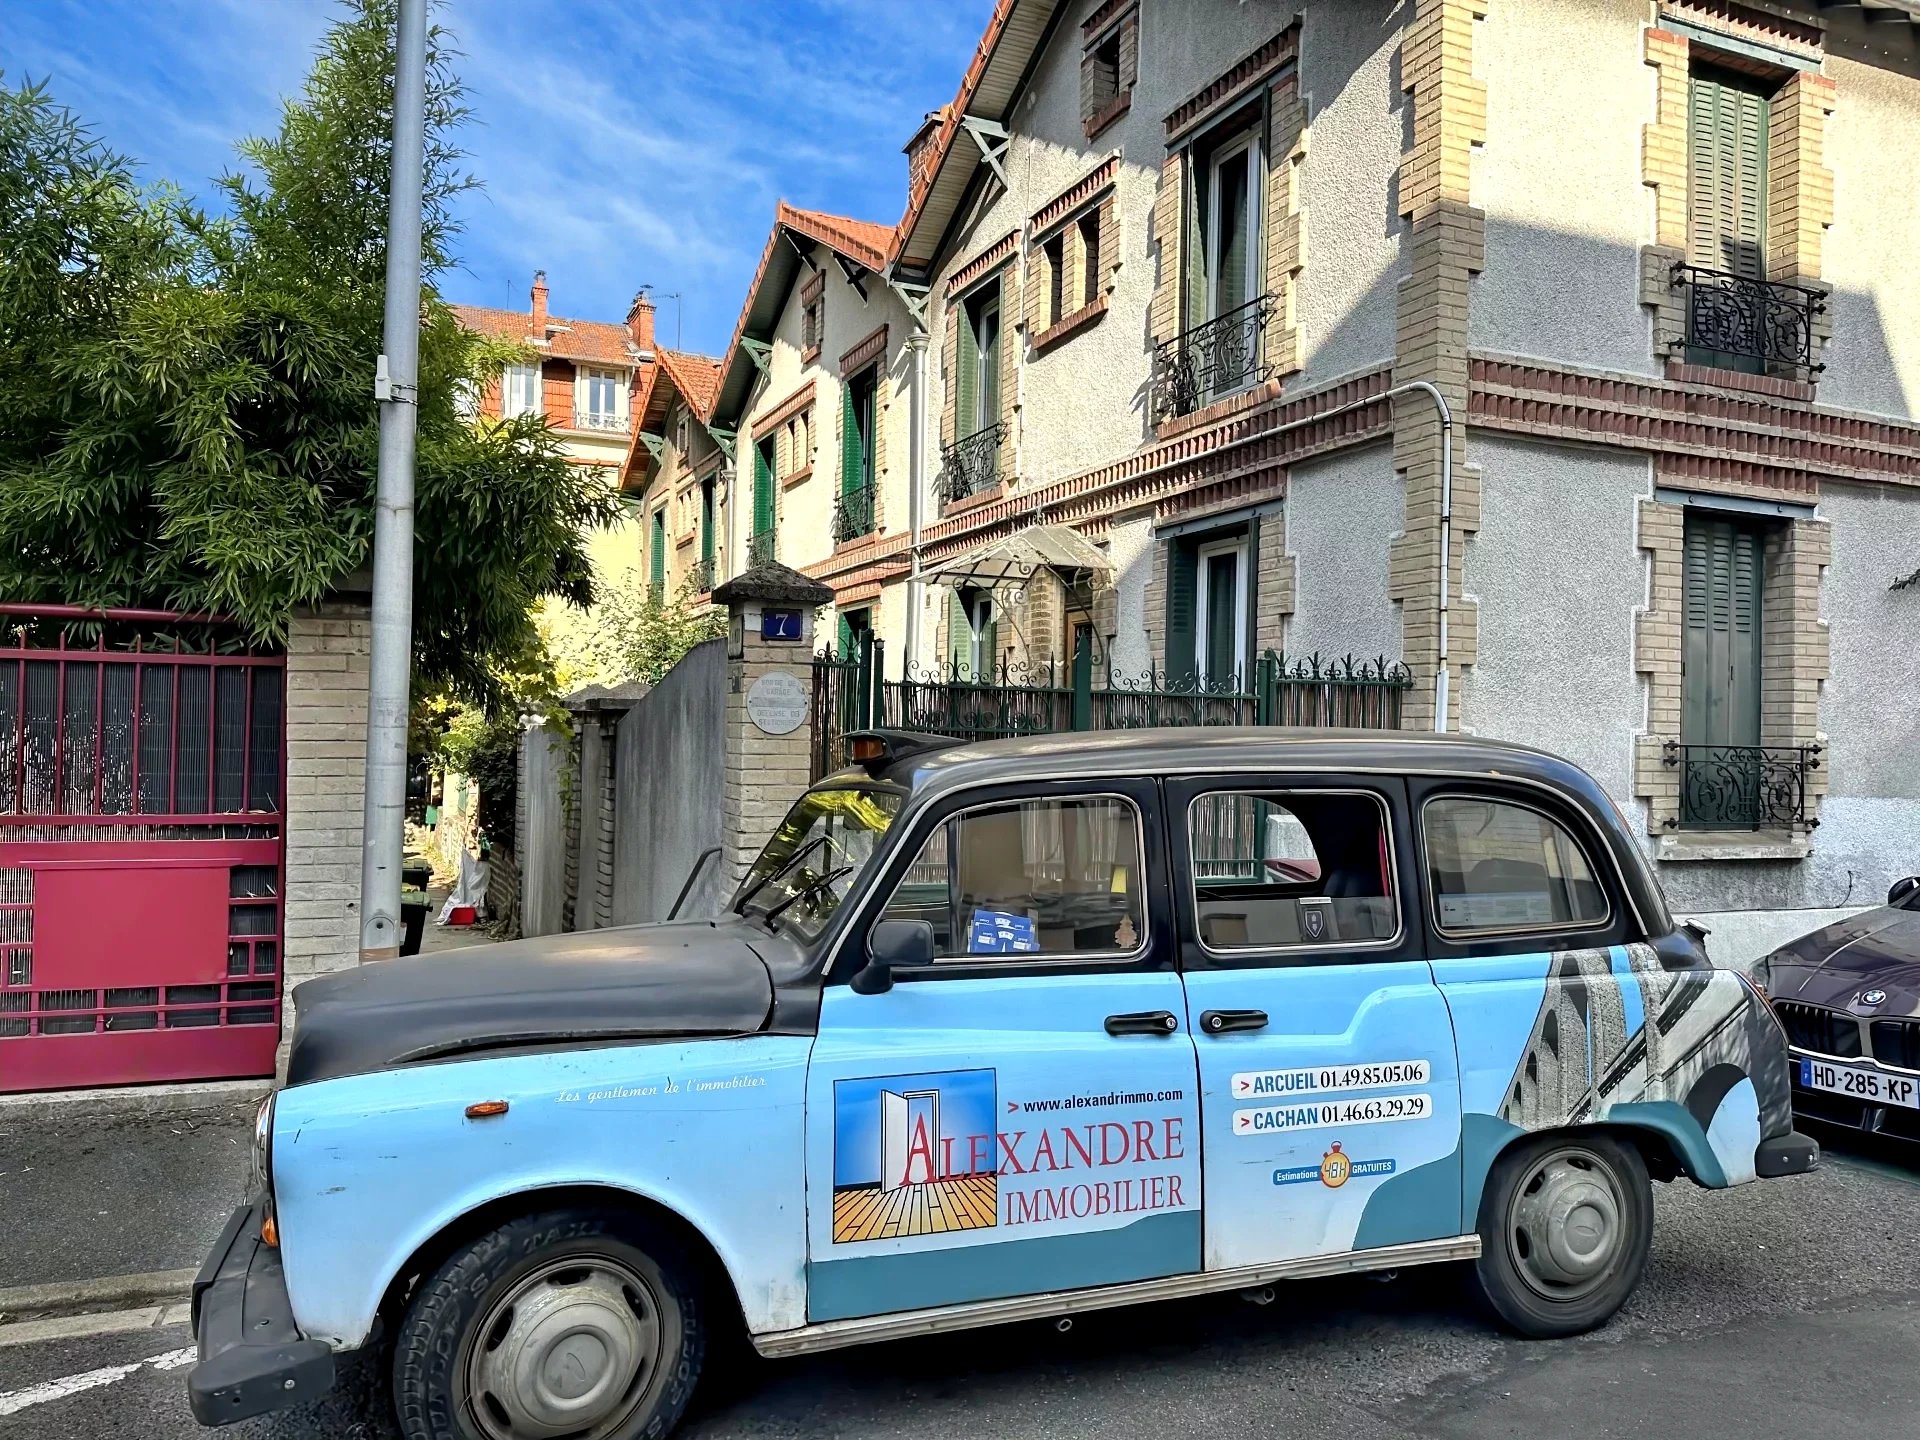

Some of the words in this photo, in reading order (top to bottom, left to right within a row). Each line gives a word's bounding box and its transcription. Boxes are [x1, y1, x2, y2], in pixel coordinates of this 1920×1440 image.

[775, 613, 789, 636] 7
[766, 688, 791, 696] GARAGE
[554, 1088, 580, 1103] Les
[587, 1086, 657, 1103] gentlemen
[664, 1079, 680, 1094] de
[686, 1074, 768, 1093] l'immobilier
[1253, 1072, 1317, 1094] ARCUEIL
[1320, 1064, 1423, 1088] 01.49.85.05.06
[1814, 1065, 1913, 1103] HD-285-KP
[1023, 1088, 1183, 1113] www.alexandrimmo.com
[1254, 1107, 1318, 1130] CACHAN
[1321, 1098, 1424, 1123] 01.46.63.29.29
[899, 1112, 1184, 1186] ALEXANDRE
[1276, 1169, 1318, 1182] Estimations
[1324, 1162, 1347, 1178] 48H
[1352, 1162, 1392, 1174] GRATUITES
[1004, 1175, 1185, 1226] IMMOBILIER
